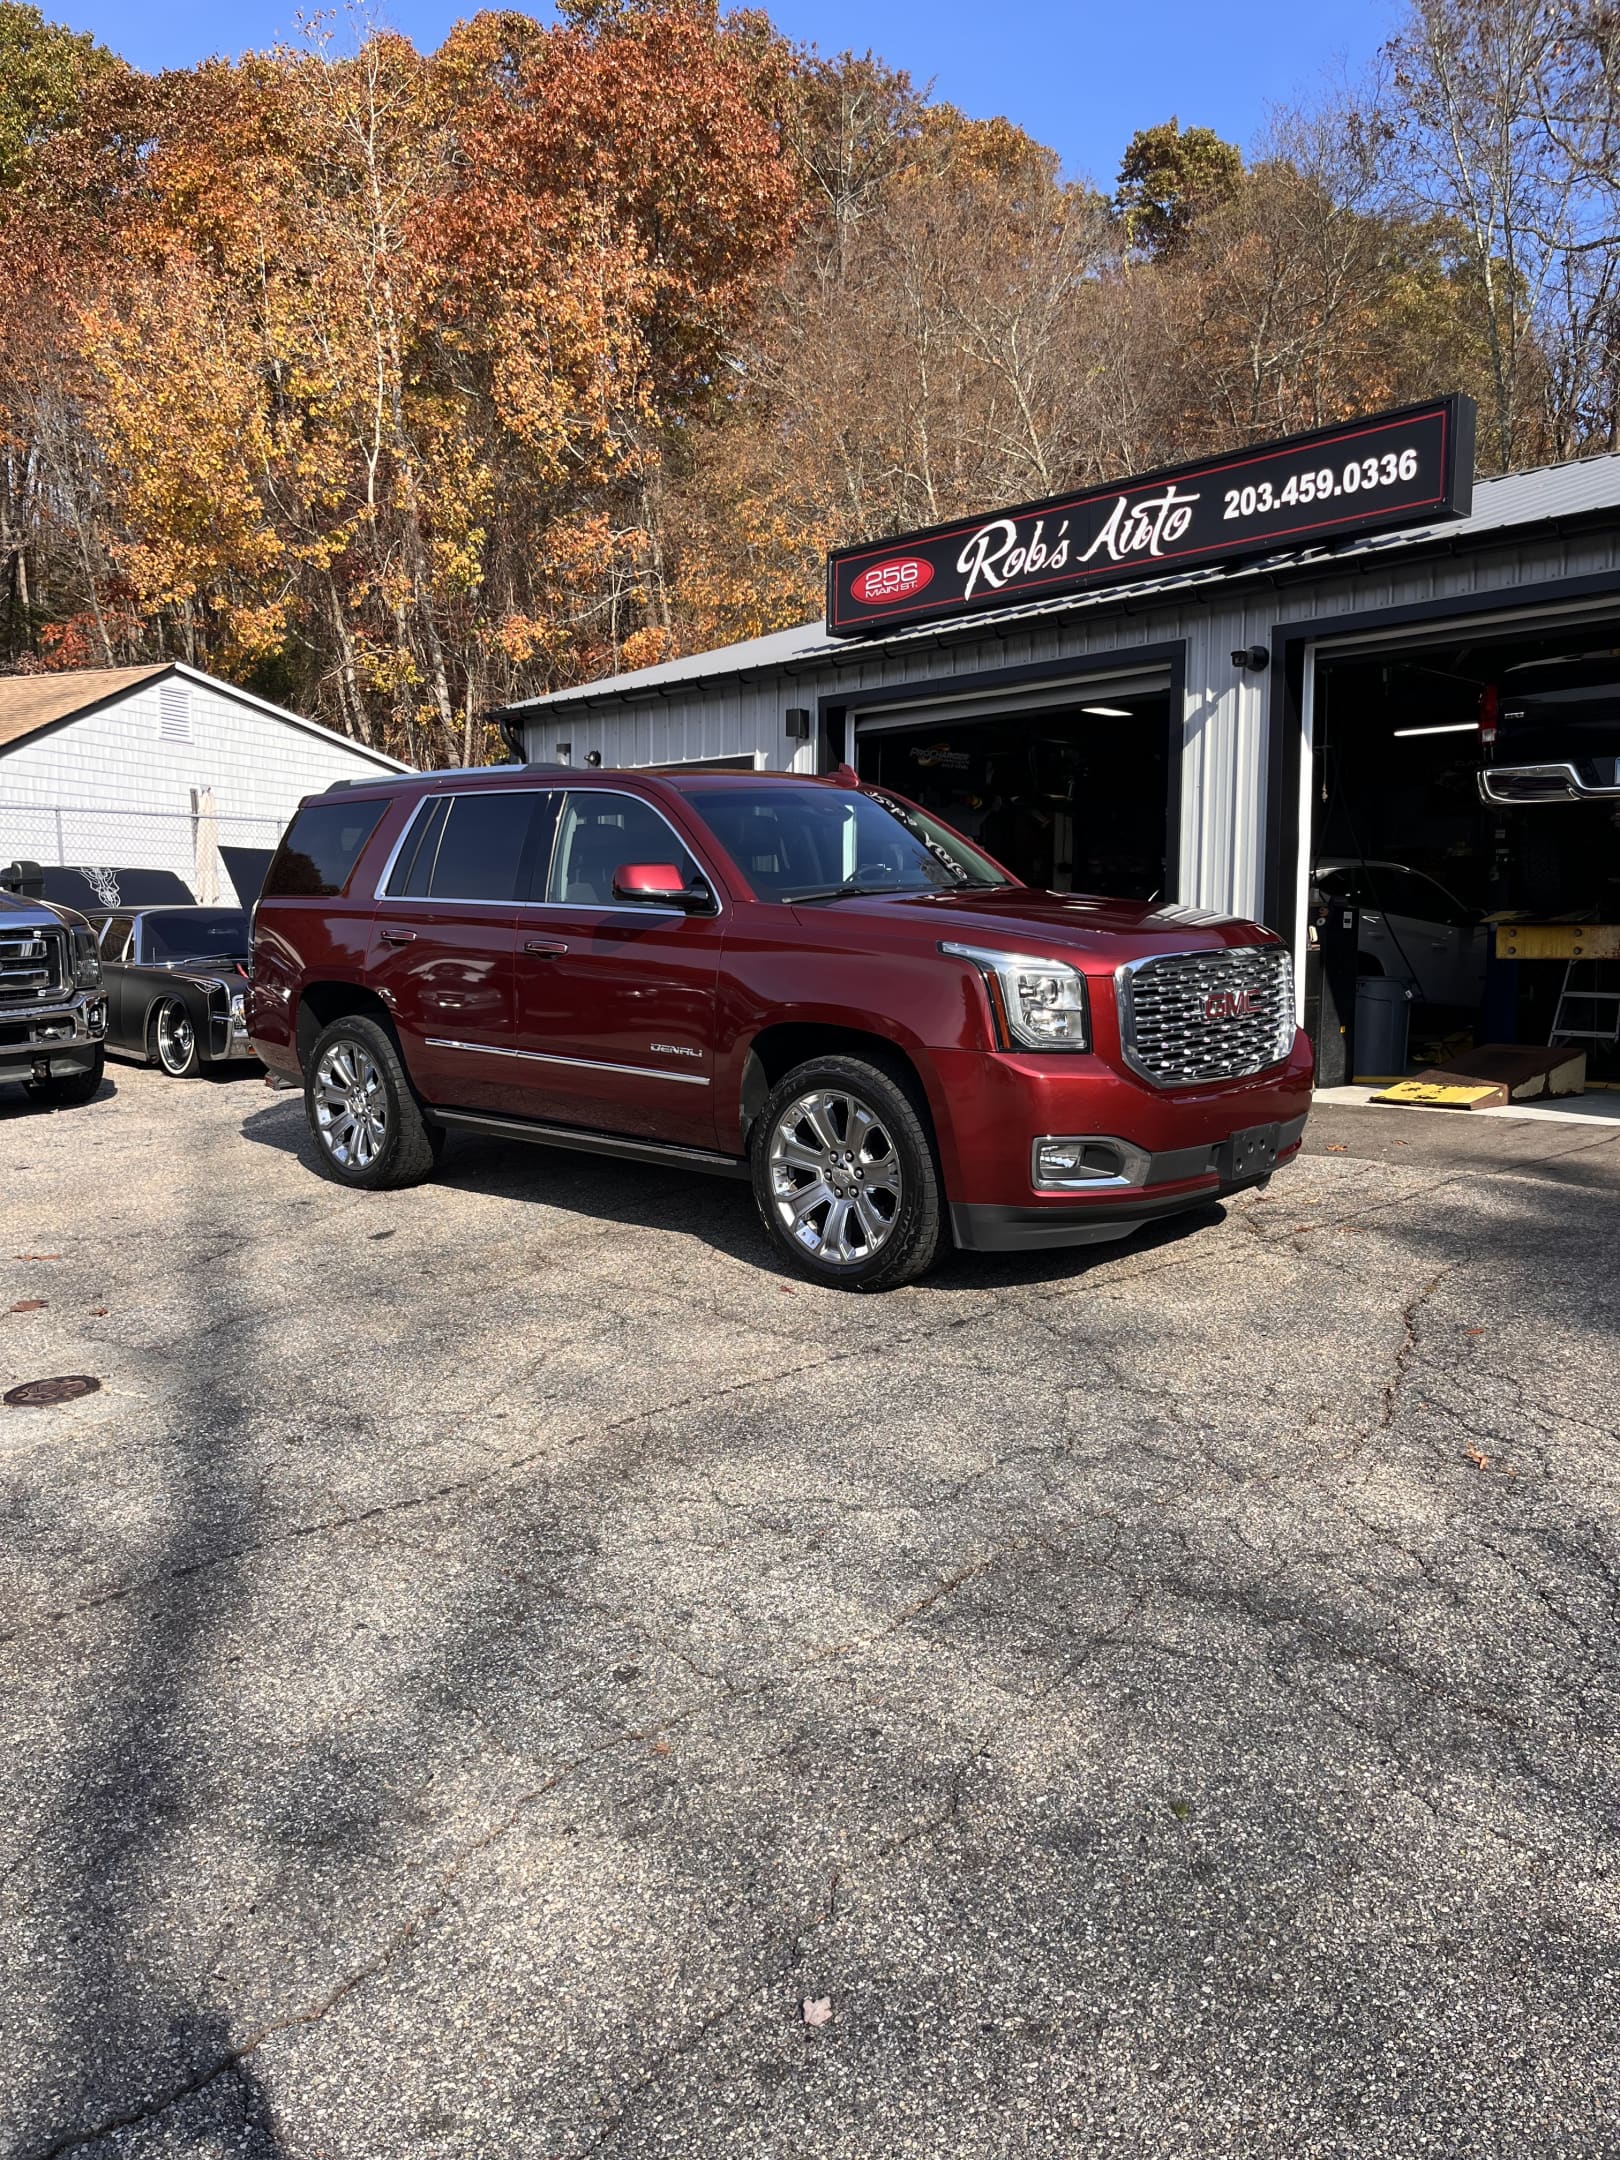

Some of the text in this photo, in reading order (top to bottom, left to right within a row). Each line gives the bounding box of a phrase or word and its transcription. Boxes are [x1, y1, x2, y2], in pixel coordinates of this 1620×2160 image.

[956, 448, 1418, 600] Rob's Auto 203.459.0336
[865, 562, 917, 590] 256
[865, 580, 917, 598] MAIN ST.
[1204, 988, 1264, 1019] GMC
[650, 1043, 703, 1058] DENALI
